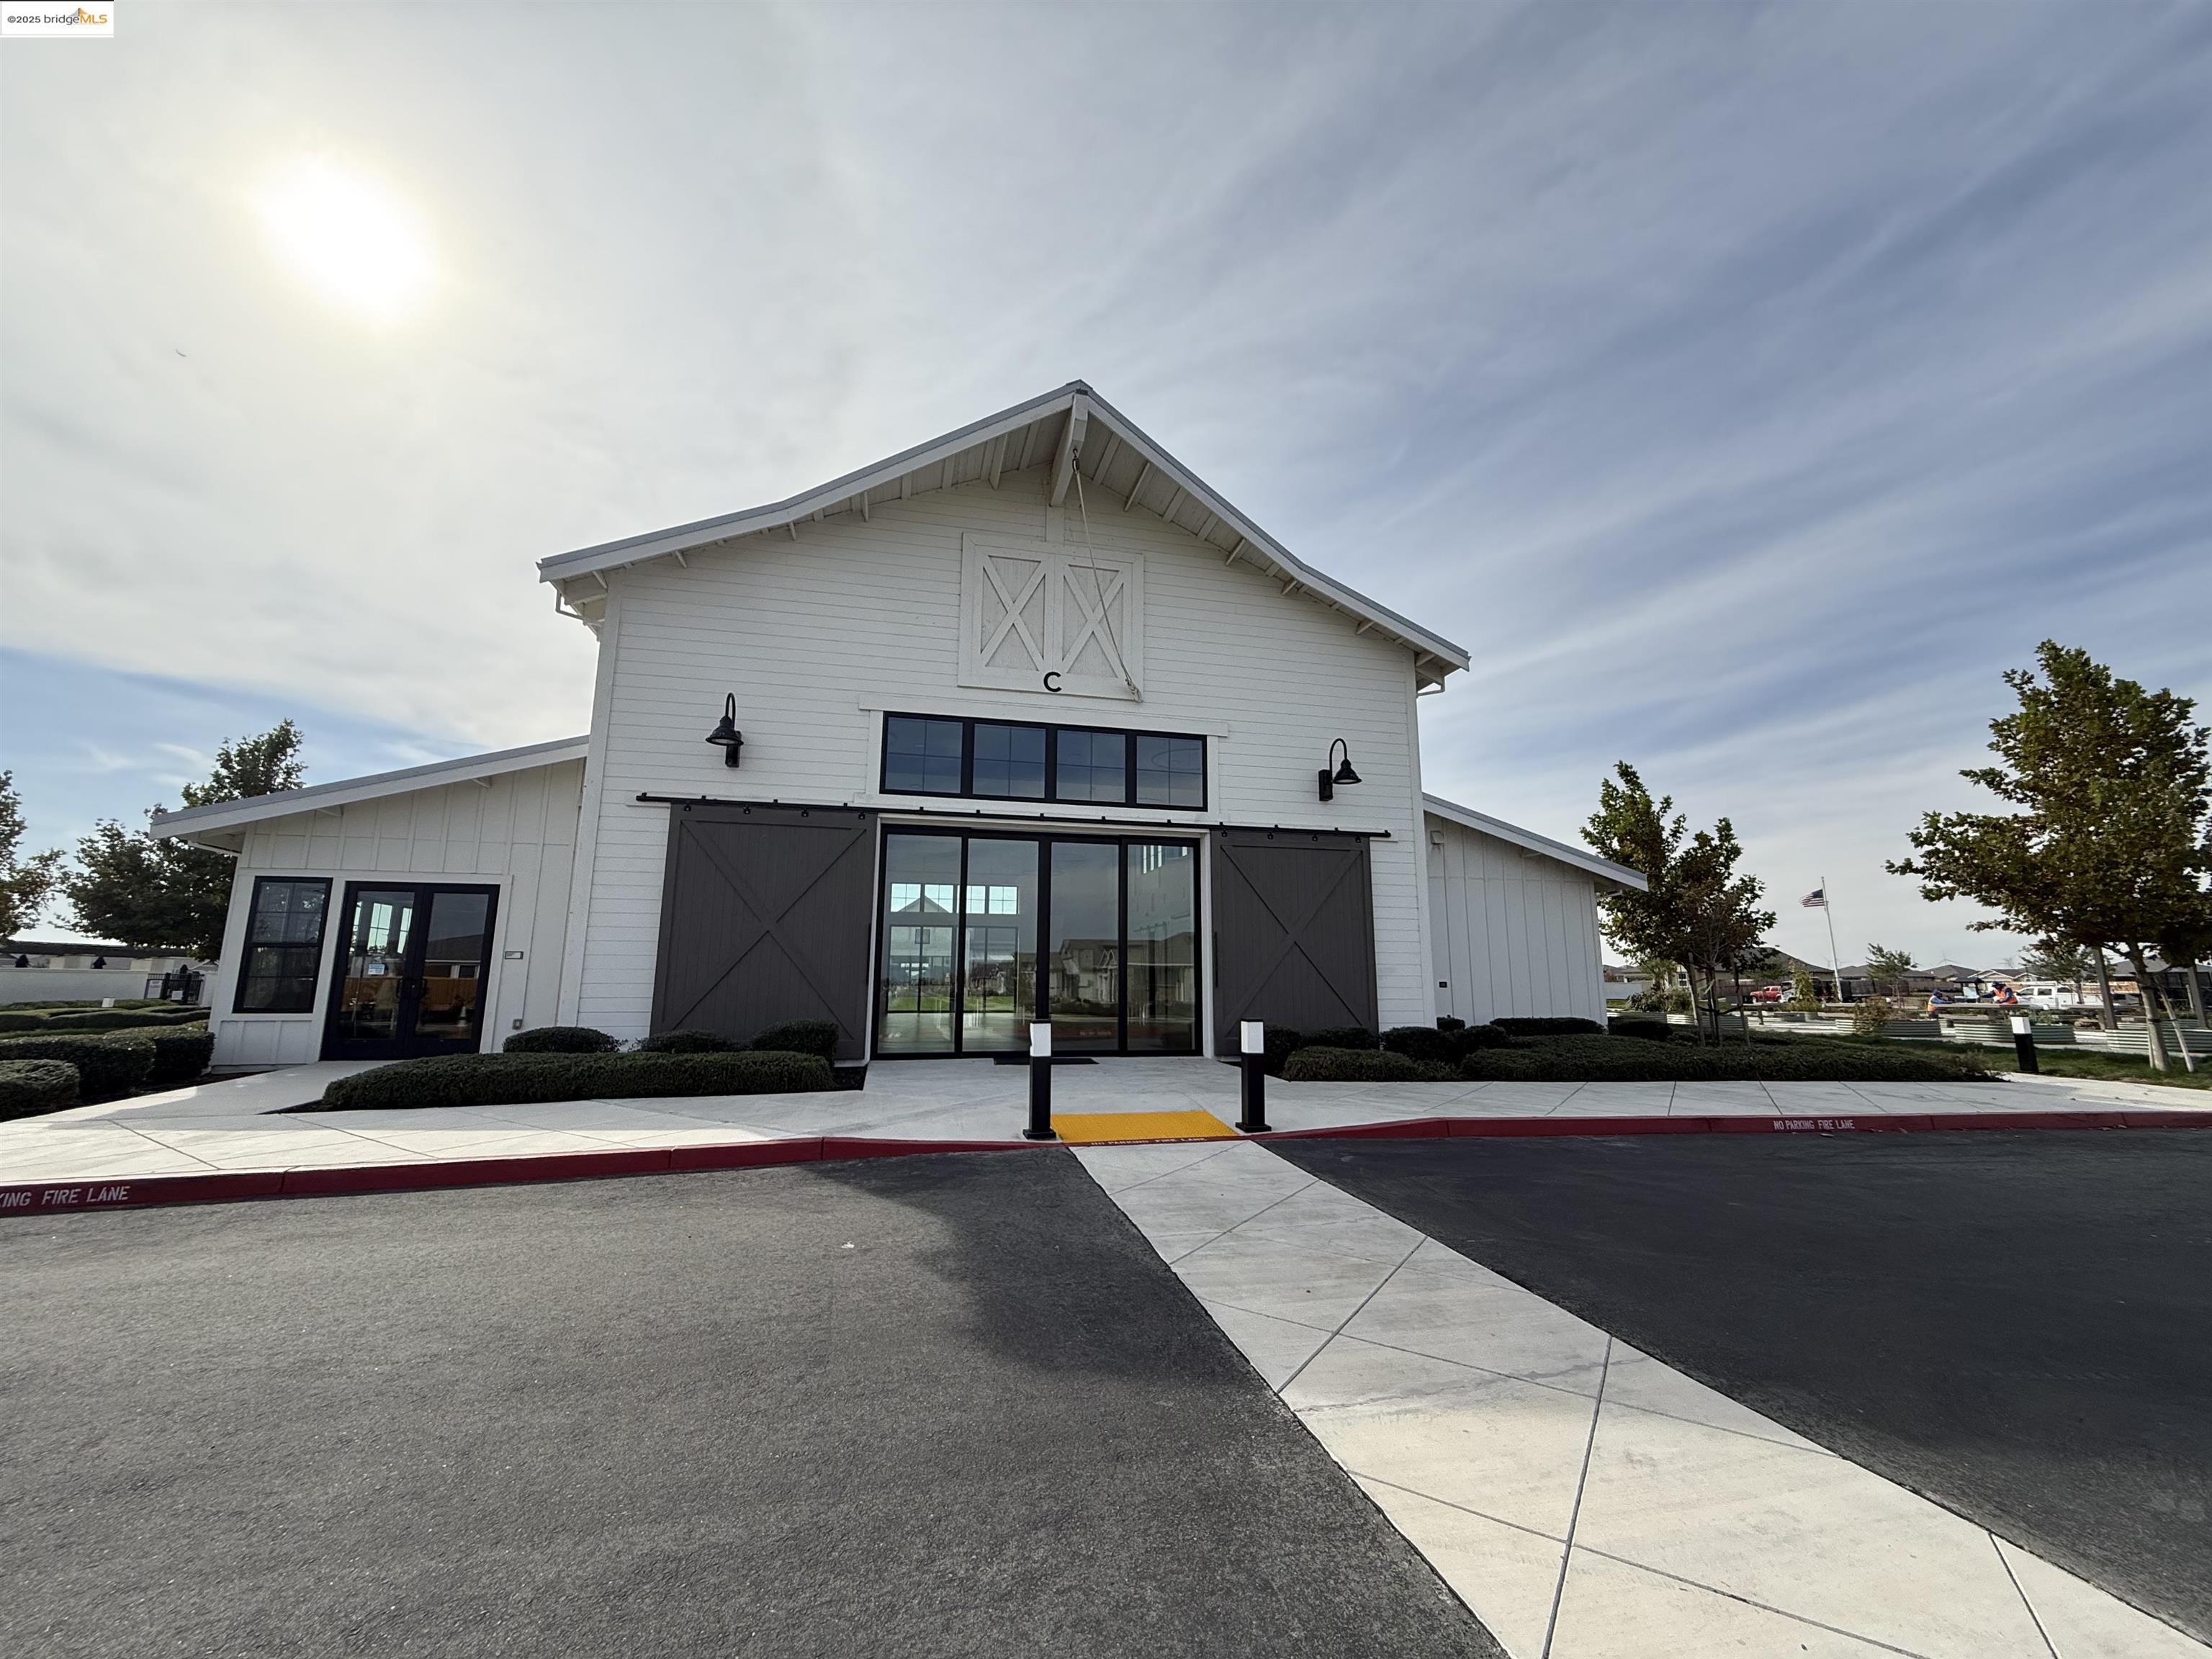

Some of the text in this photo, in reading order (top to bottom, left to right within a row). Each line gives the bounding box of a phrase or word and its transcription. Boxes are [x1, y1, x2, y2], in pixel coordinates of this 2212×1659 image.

[1043, 671, 1062, 693] C
[1773, 1120, 1855, 1130] NO PARKING FIRE LANE
[41, 1188, 81, 1205] FIRE
[86, 1186, 130, 1202] LANE
